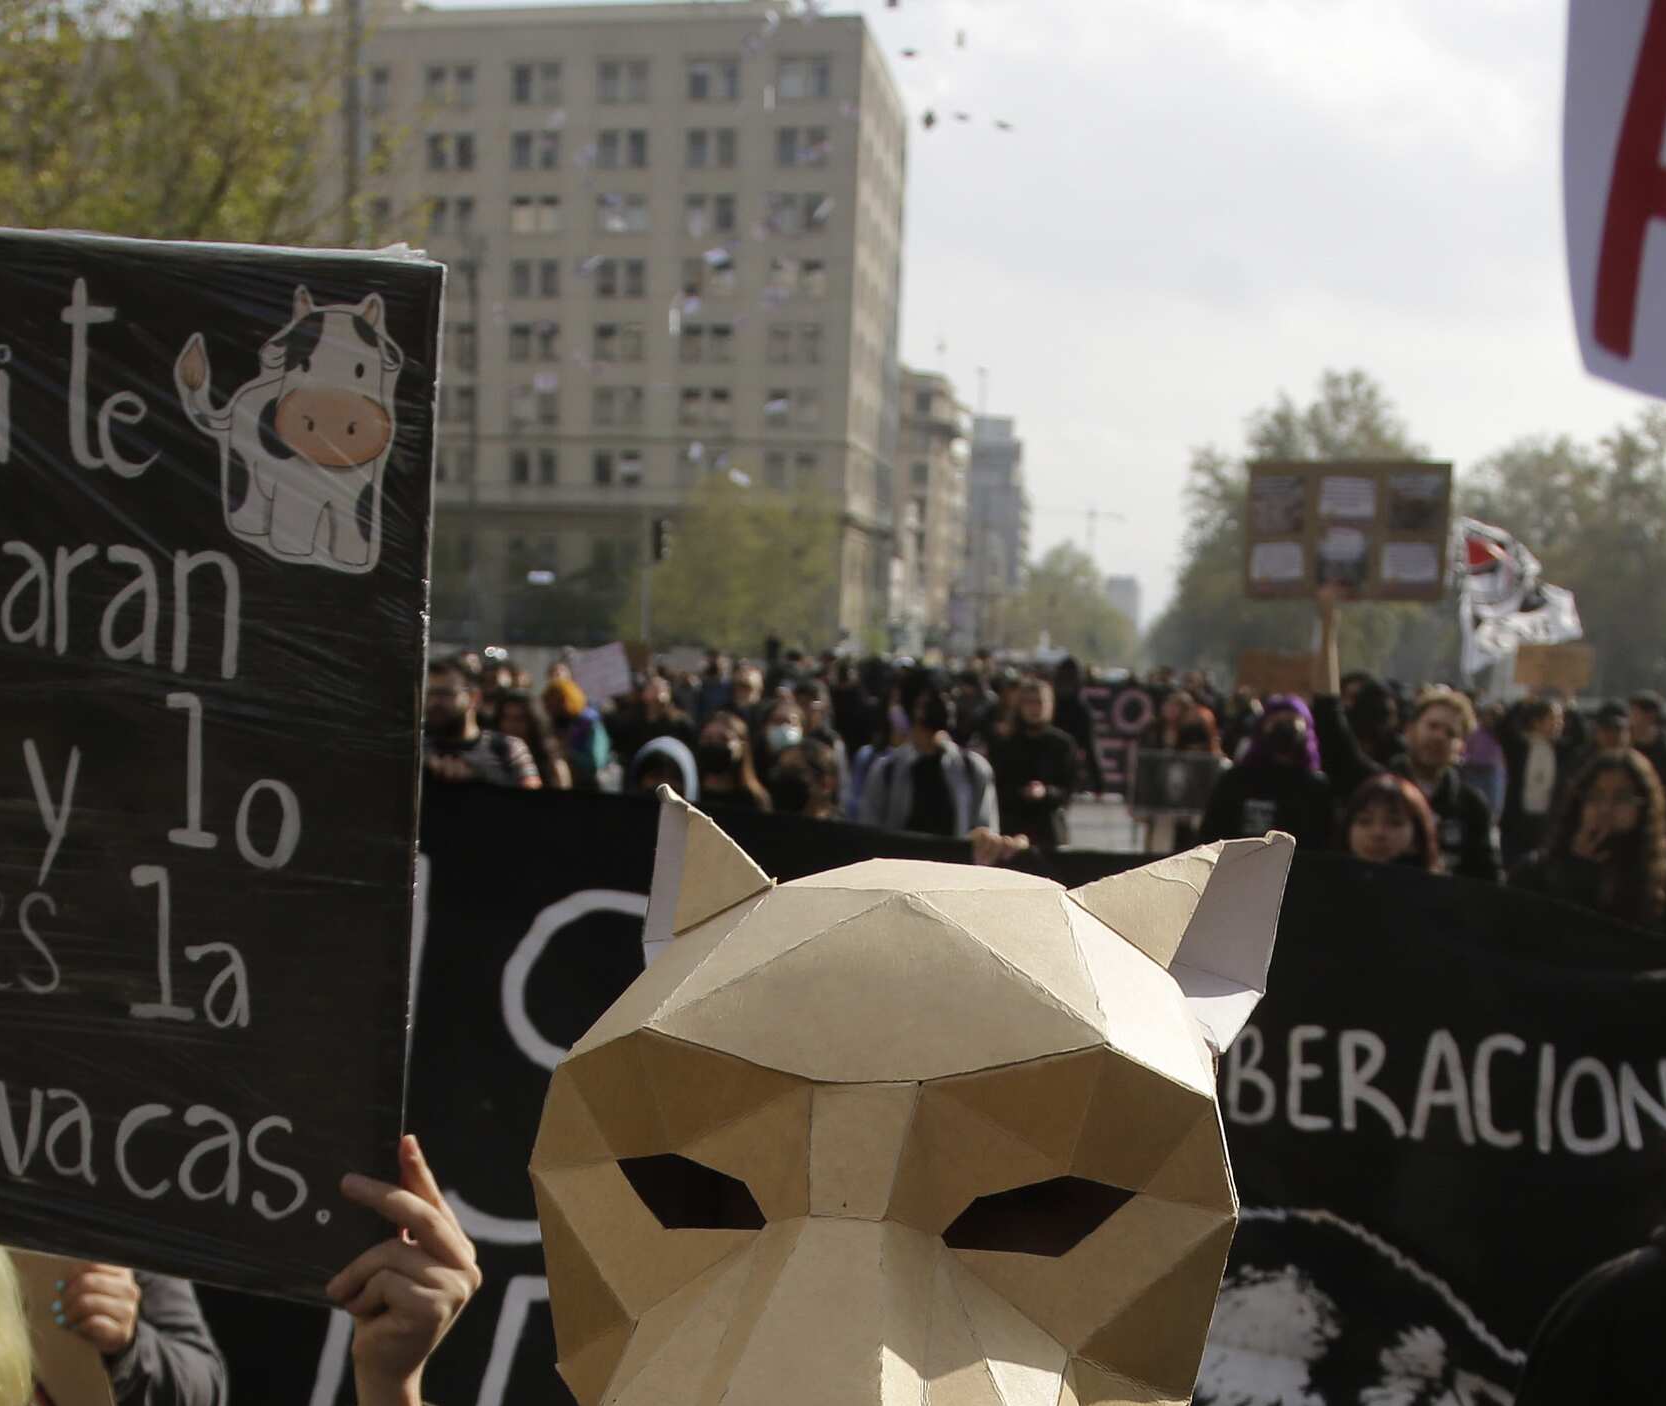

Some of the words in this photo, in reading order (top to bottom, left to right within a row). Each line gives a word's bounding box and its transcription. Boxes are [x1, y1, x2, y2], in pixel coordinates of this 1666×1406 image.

[61, 278, 161, 478] te
[23, 739, 81, 885] y
[167, 692, 302, 870] lo
[130, 865, 250, 1028] la
